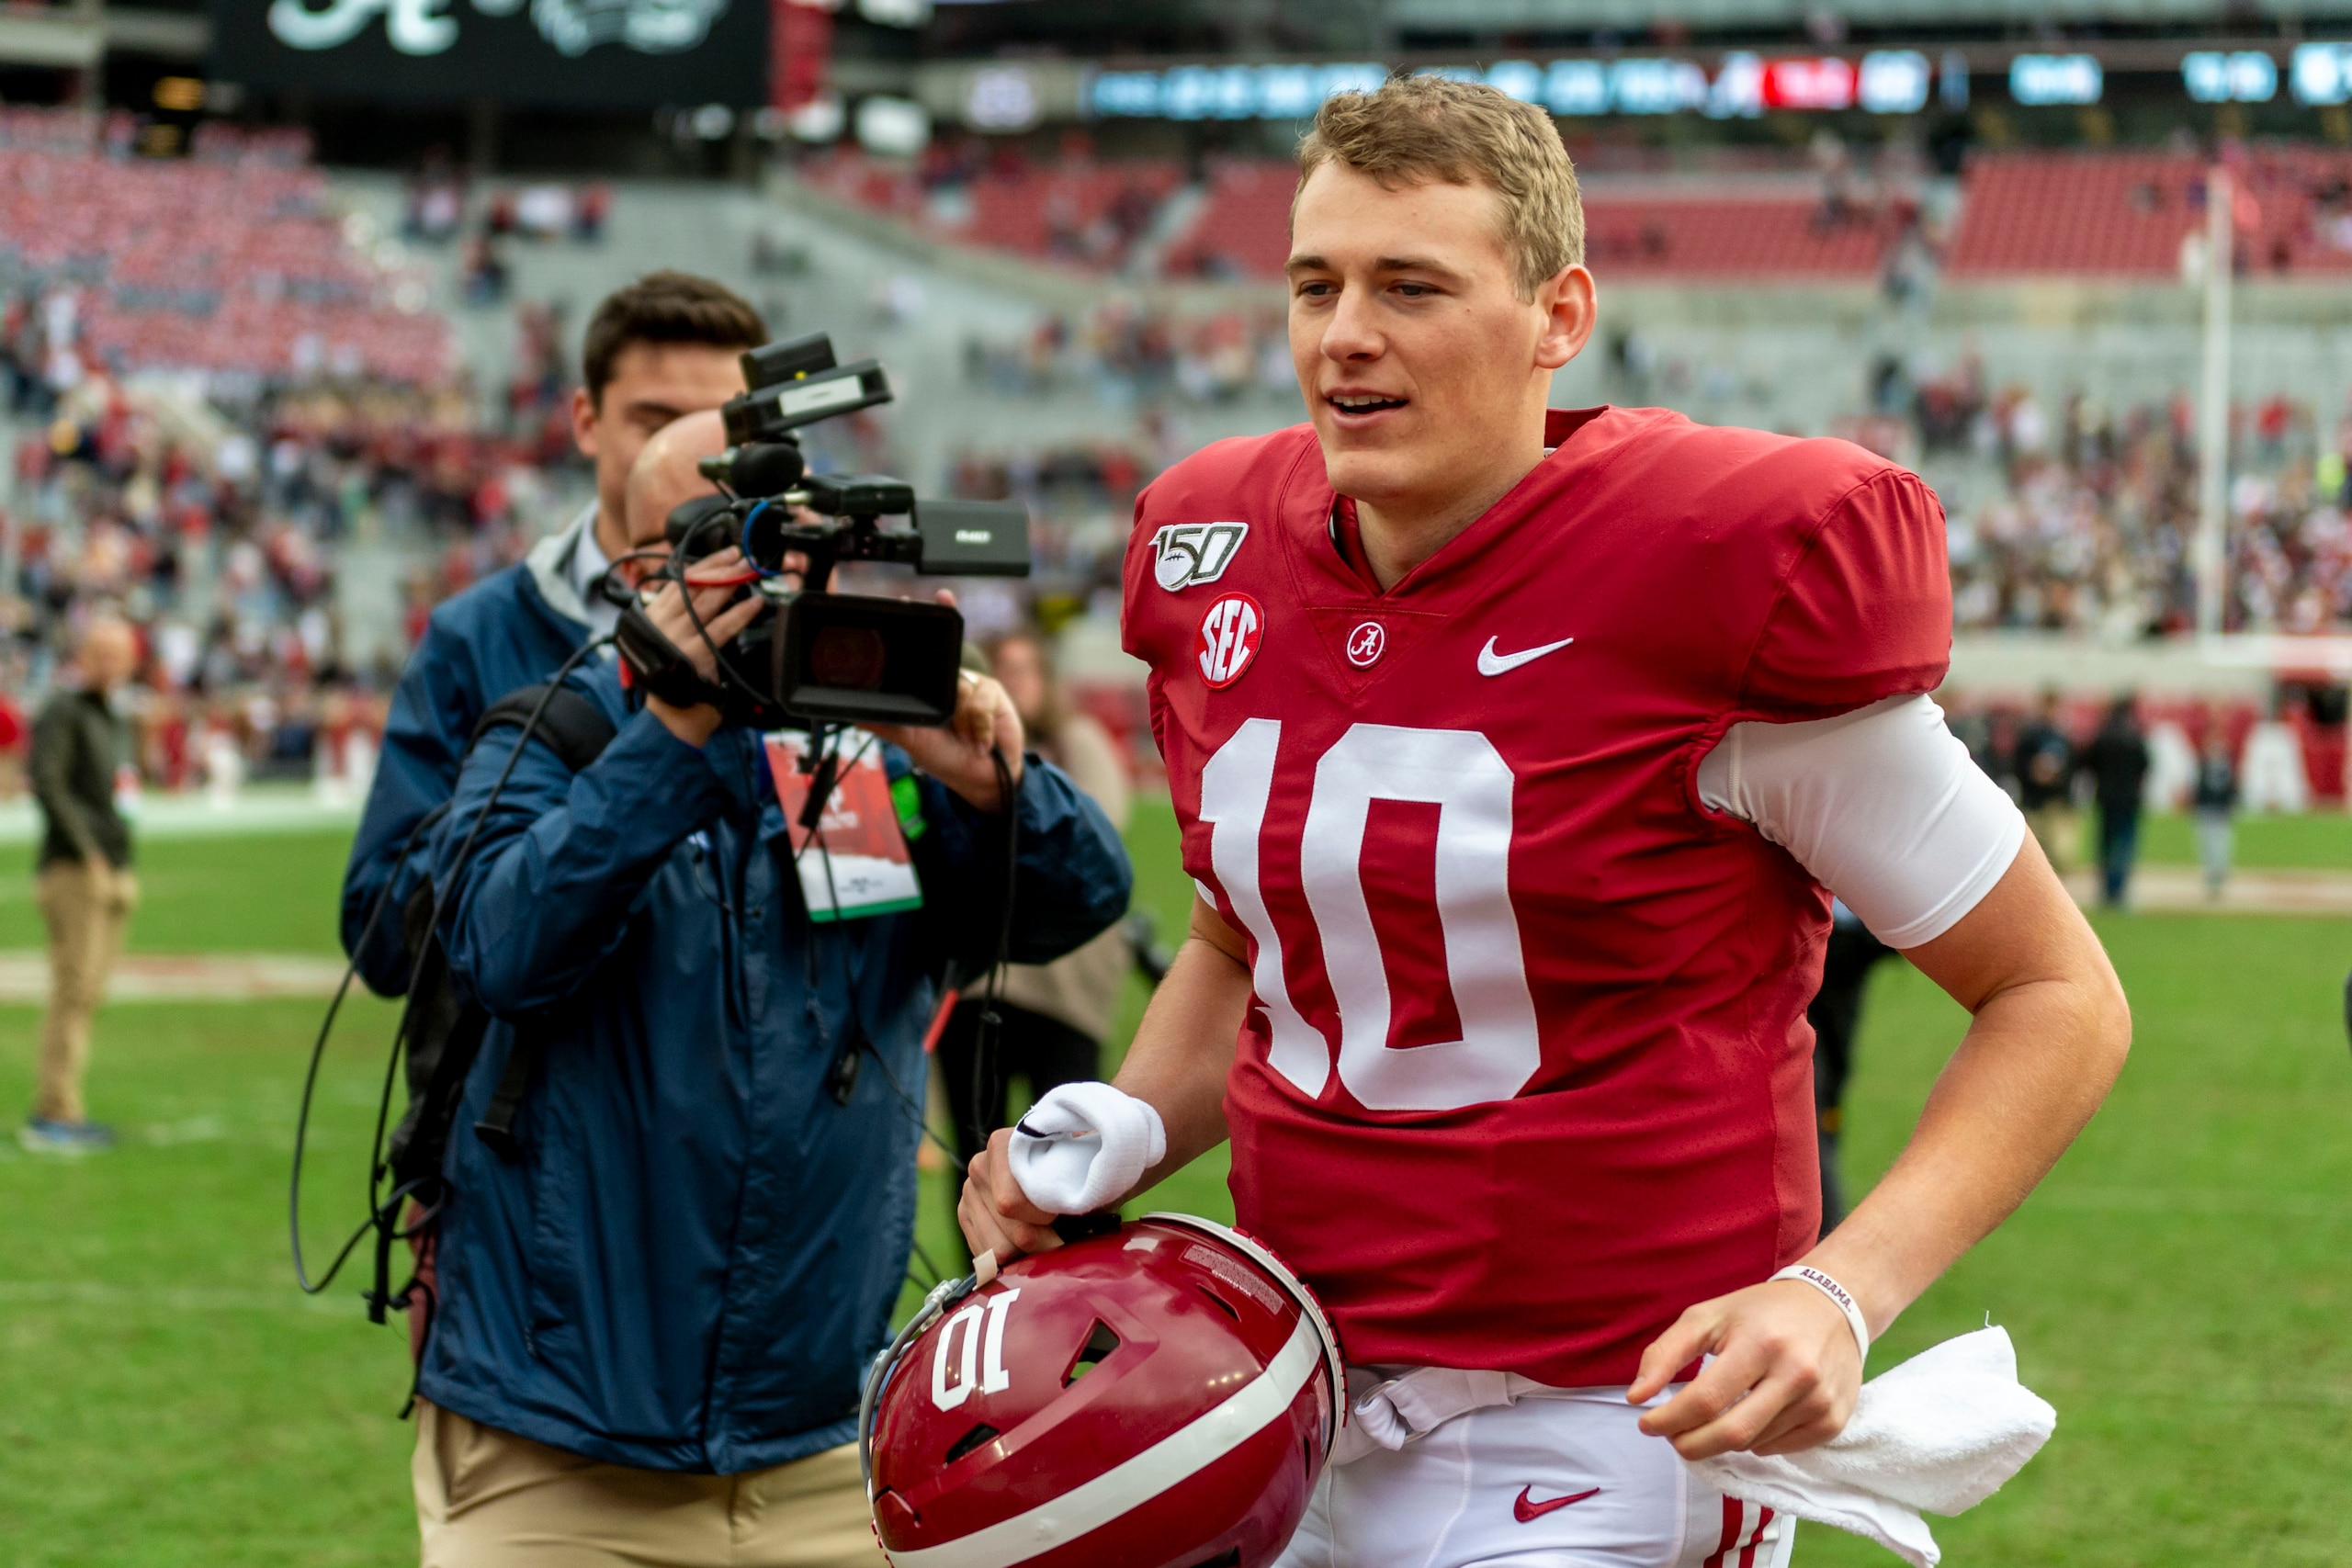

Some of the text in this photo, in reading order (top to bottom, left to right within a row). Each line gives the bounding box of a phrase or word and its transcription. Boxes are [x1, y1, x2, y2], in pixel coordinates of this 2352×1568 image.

[1151, 524, 1247, 590] 150
[1199, 599, 1257, 682] SEC
[1351, 628, 1381, 657] A
[1199, 717, 1542, 1111] 10
[1211, 1269, 1251, 1297] WARNING
[932, 1288, 1021, 1412] 10
